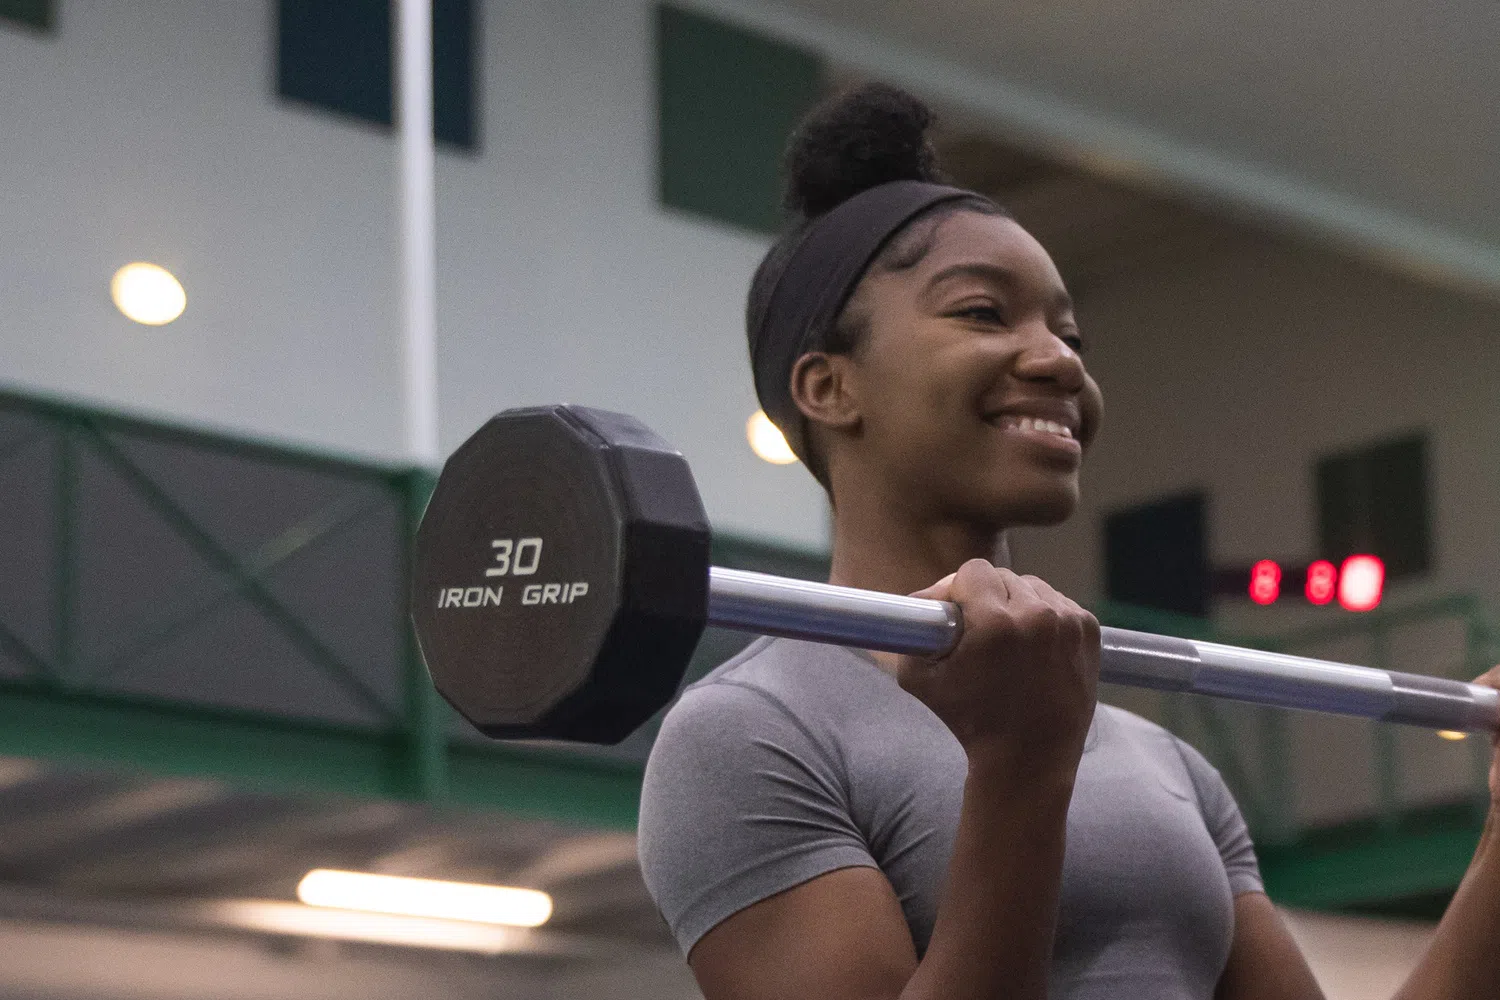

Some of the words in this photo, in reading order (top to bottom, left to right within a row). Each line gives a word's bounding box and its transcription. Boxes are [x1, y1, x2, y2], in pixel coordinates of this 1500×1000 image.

[485, 537, 544, 577] 30
[437, 585, 504, 609] IRON
[521, 582, 589, 606] GRIP
